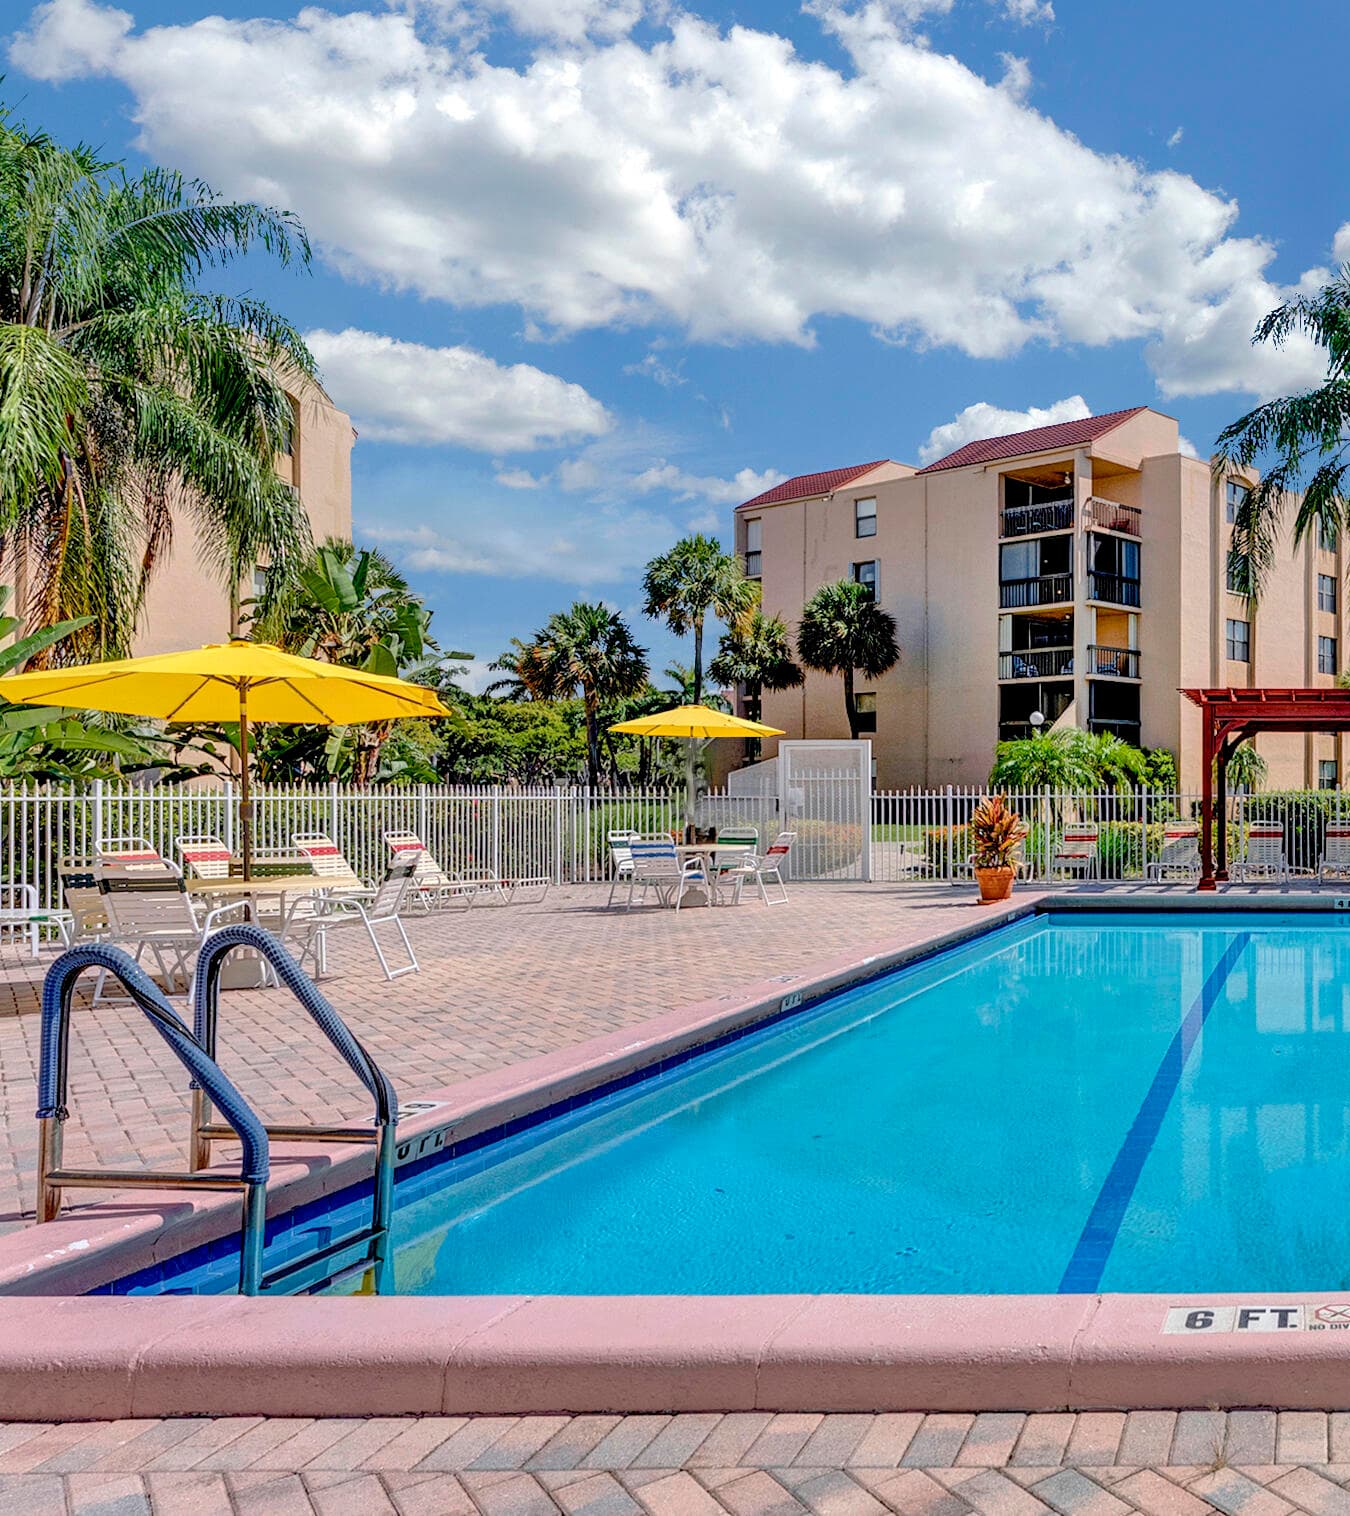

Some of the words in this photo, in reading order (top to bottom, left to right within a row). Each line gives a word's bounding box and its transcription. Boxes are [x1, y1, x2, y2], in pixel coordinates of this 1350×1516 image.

[1337, 900, 1344, 908] 4
[1185, 1310, 1215, 1329] 6
[1237, 1308, 1298, 1329] FT.
[1308, 1323, 1326, 1331] NO
